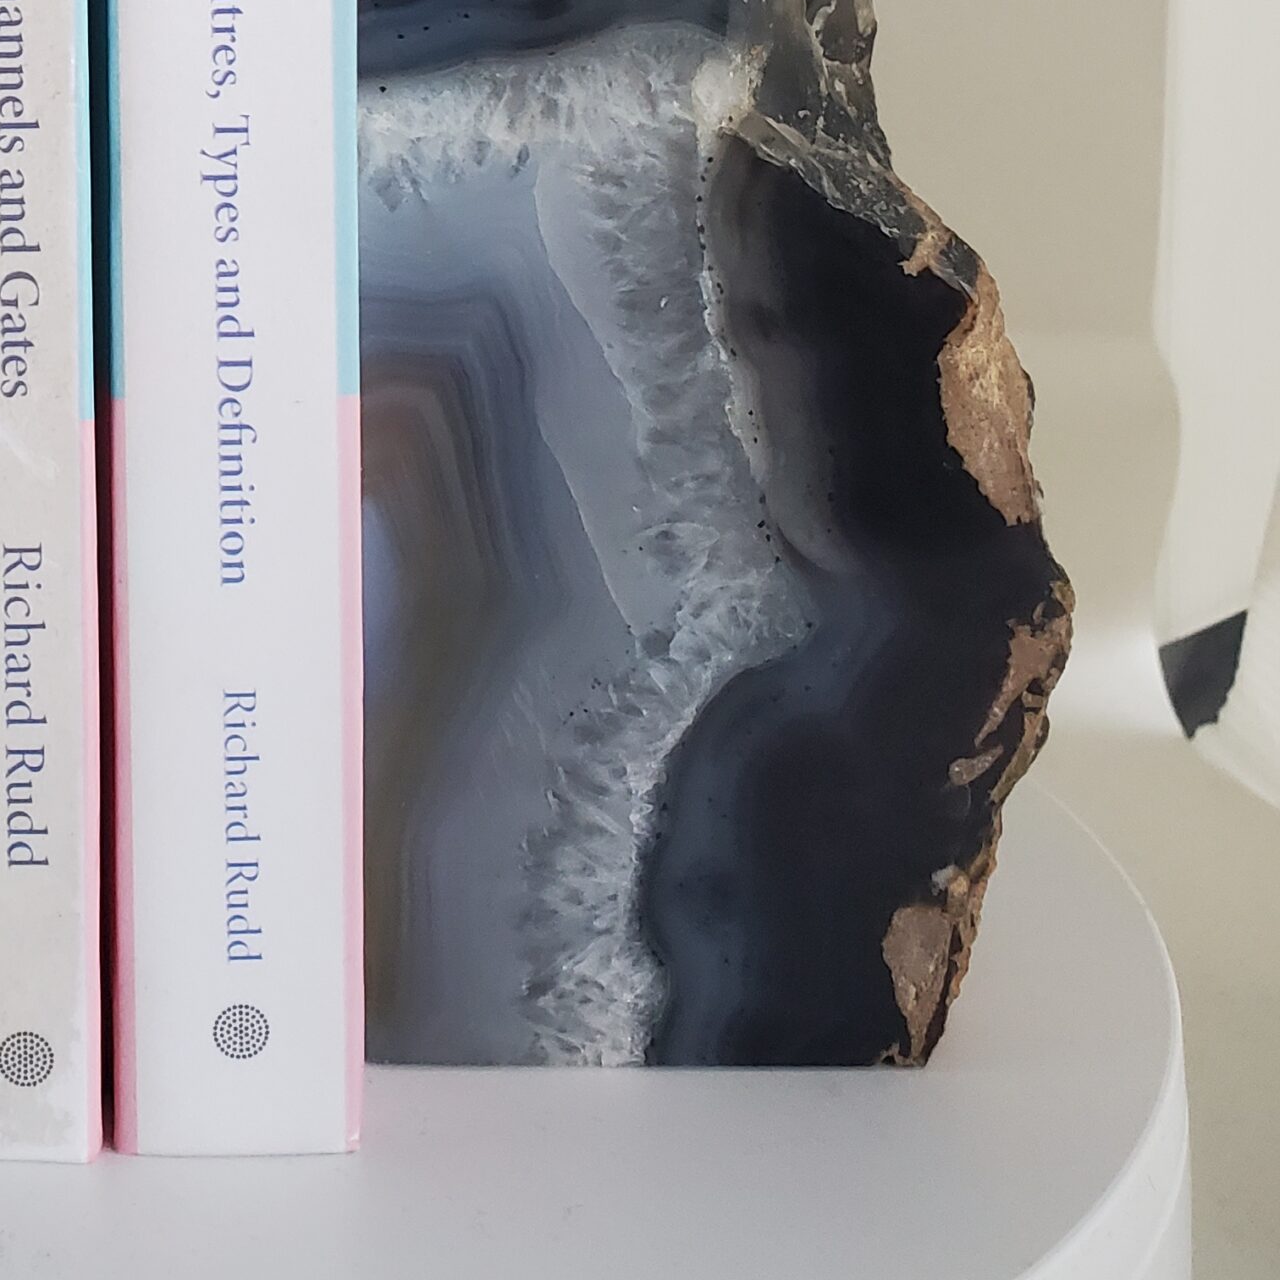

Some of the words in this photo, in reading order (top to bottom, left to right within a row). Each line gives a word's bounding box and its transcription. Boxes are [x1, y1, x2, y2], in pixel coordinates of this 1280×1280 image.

[199, 114, 251, 243] Types
[215, 258, 256, 338] and
[217, 358, 258, 584] Definition
[2, 542, 48, 728] Richard
[5, 745, 50, 868] Rudd
[223, 691, 262, 843] Richard
[225, 861, 263, 961] Rudd
